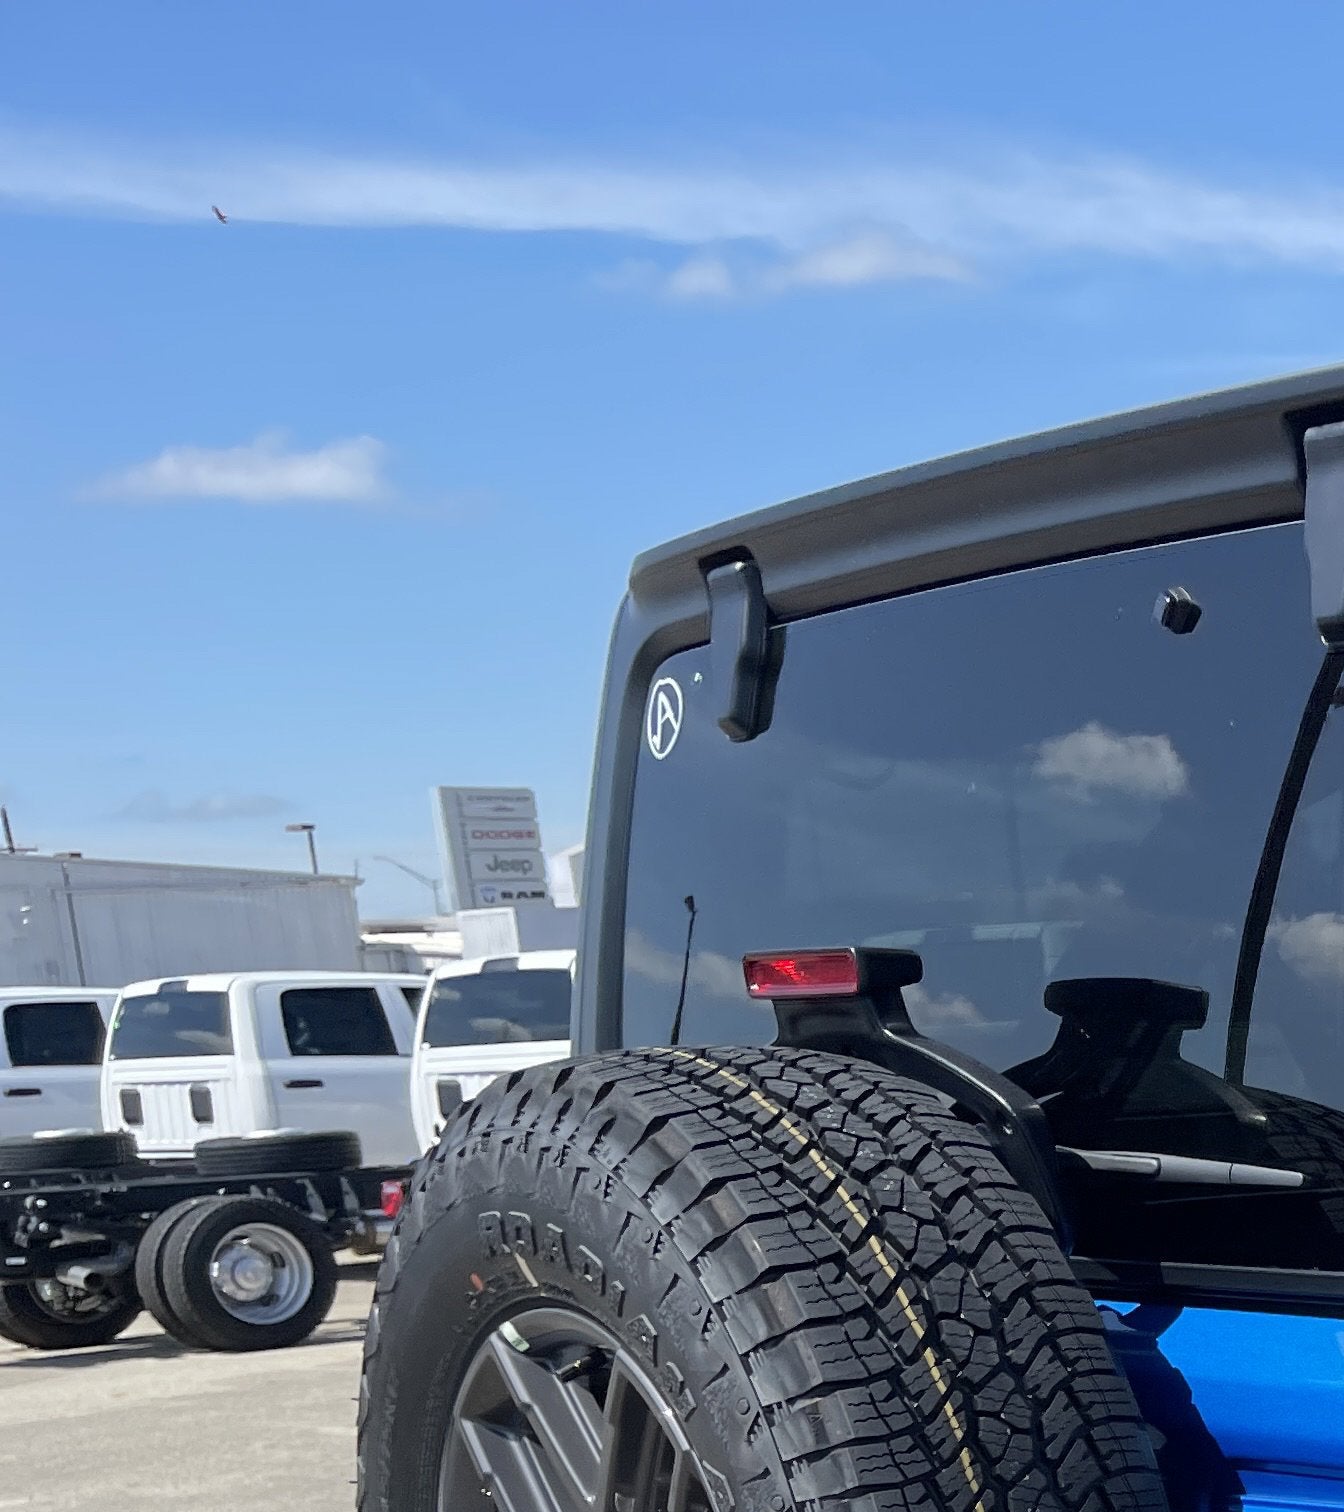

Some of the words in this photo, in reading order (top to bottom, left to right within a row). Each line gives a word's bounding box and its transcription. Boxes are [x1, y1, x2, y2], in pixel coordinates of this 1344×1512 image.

[471, 829, 535, 840] DODGE
[485, 854, 533, 876] Jeep
[501, 890, 545, 899] RAM
